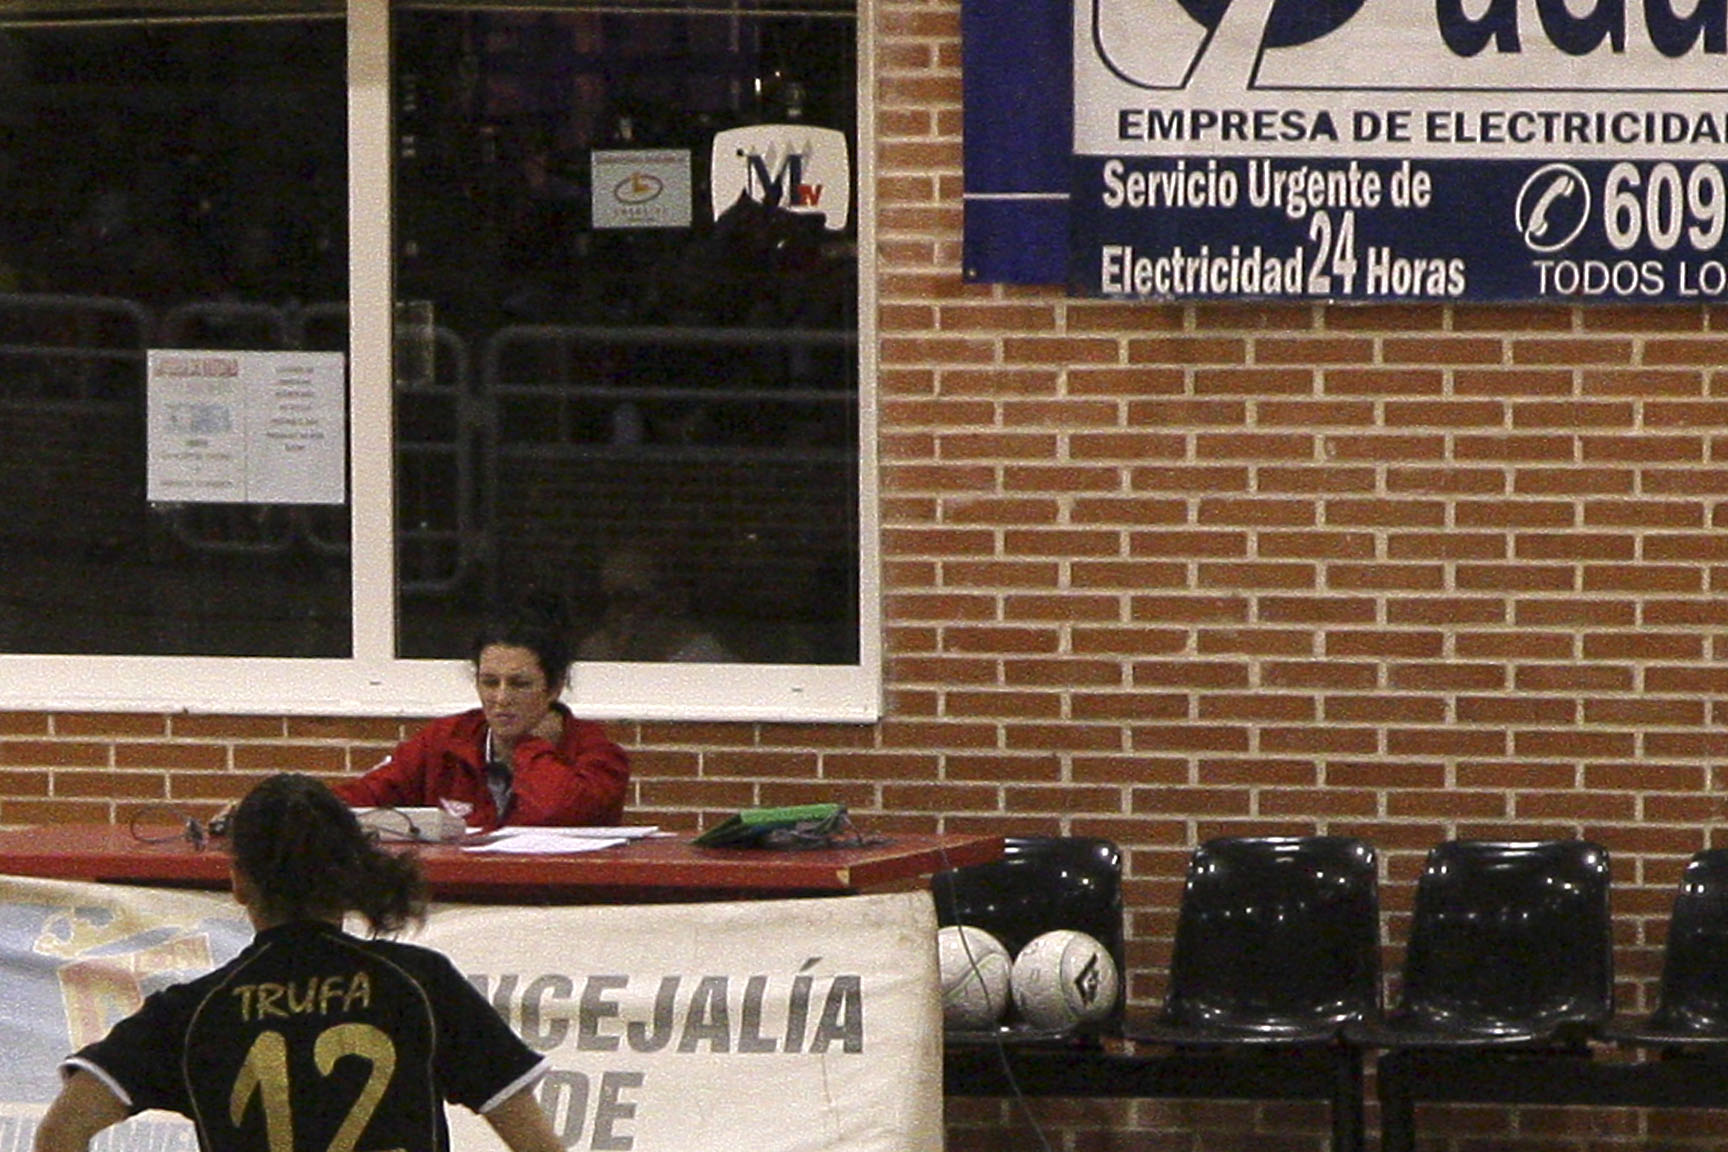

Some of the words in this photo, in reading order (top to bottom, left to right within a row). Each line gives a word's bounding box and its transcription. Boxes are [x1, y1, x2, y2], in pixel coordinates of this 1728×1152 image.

[1118, 109, 1339, 142] EMPRESA
[1353, 110, 1412, 142] DE
[1426, 111, 1728, 144] ELECTRICIDA
[1102, 159, 1238, 208] Servicio
[1248, 159, 1382, 218] Urgente
[1391, 160, 1432, 208] de
[1603, 161, 1727, 251] 609
[1101, 246, 1303, 295] Electricidad
[1308, 210, 1358, 295] 24
[1366, 246, 1466, 296] Horas
[1533, 260, 1665, 295] TODOS
[234, 970, 371, 1021] TRUFA
